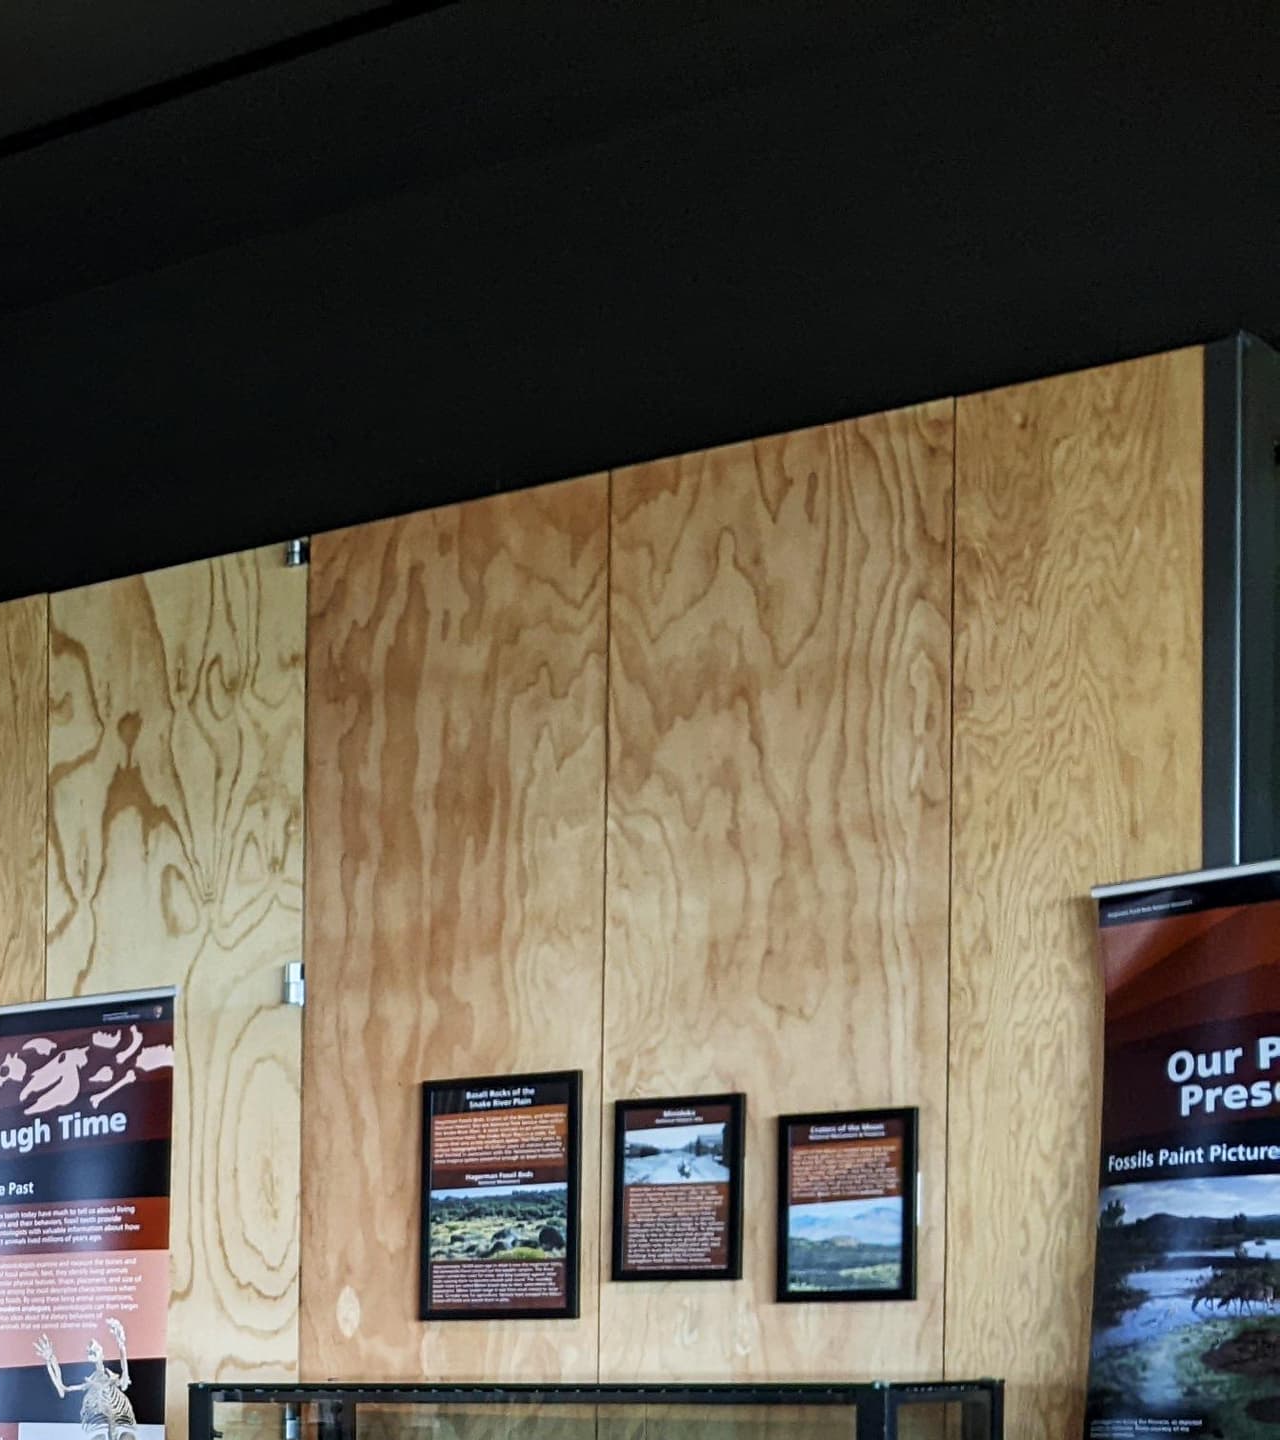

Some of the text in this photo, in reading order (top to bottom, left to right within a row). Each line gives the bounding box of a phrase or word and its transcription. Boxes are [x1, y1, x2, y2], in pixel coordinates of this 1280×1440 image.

[1168, 1047, 1243, 1082] Our
[59, 1110, 127, 1139] Time
[1109, 1149, 1154, 1172] Fossils
[1159, 1146, 1204, 1166] Paint
[8, 1182, 34, 1195] Past
